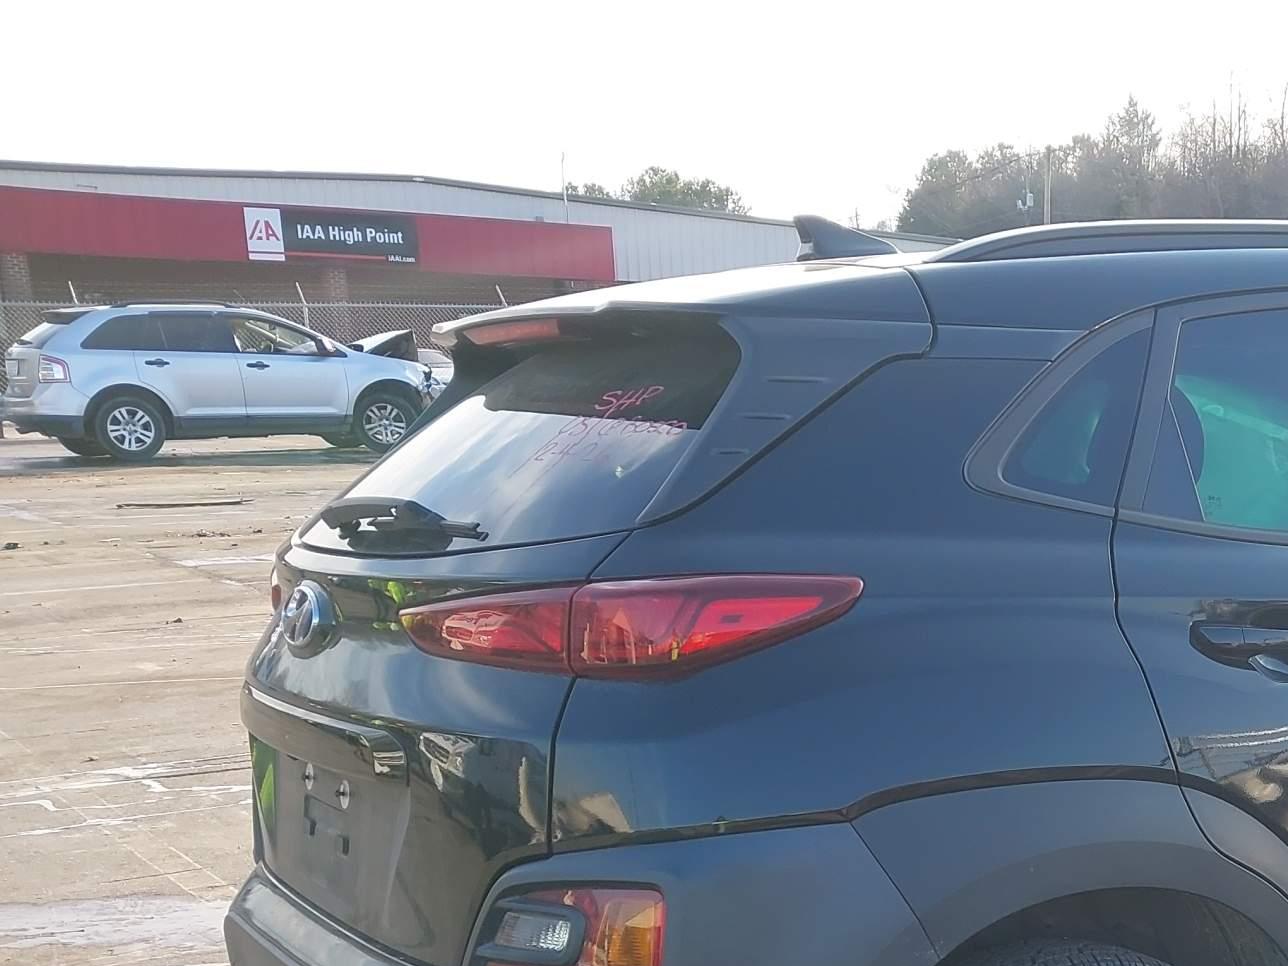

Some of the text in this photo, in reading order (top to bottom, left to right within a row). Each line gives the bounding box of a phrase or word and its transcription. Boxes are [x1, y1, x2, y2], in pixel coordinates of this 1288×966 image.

[296, 224, 404, 244] IAA High Point
